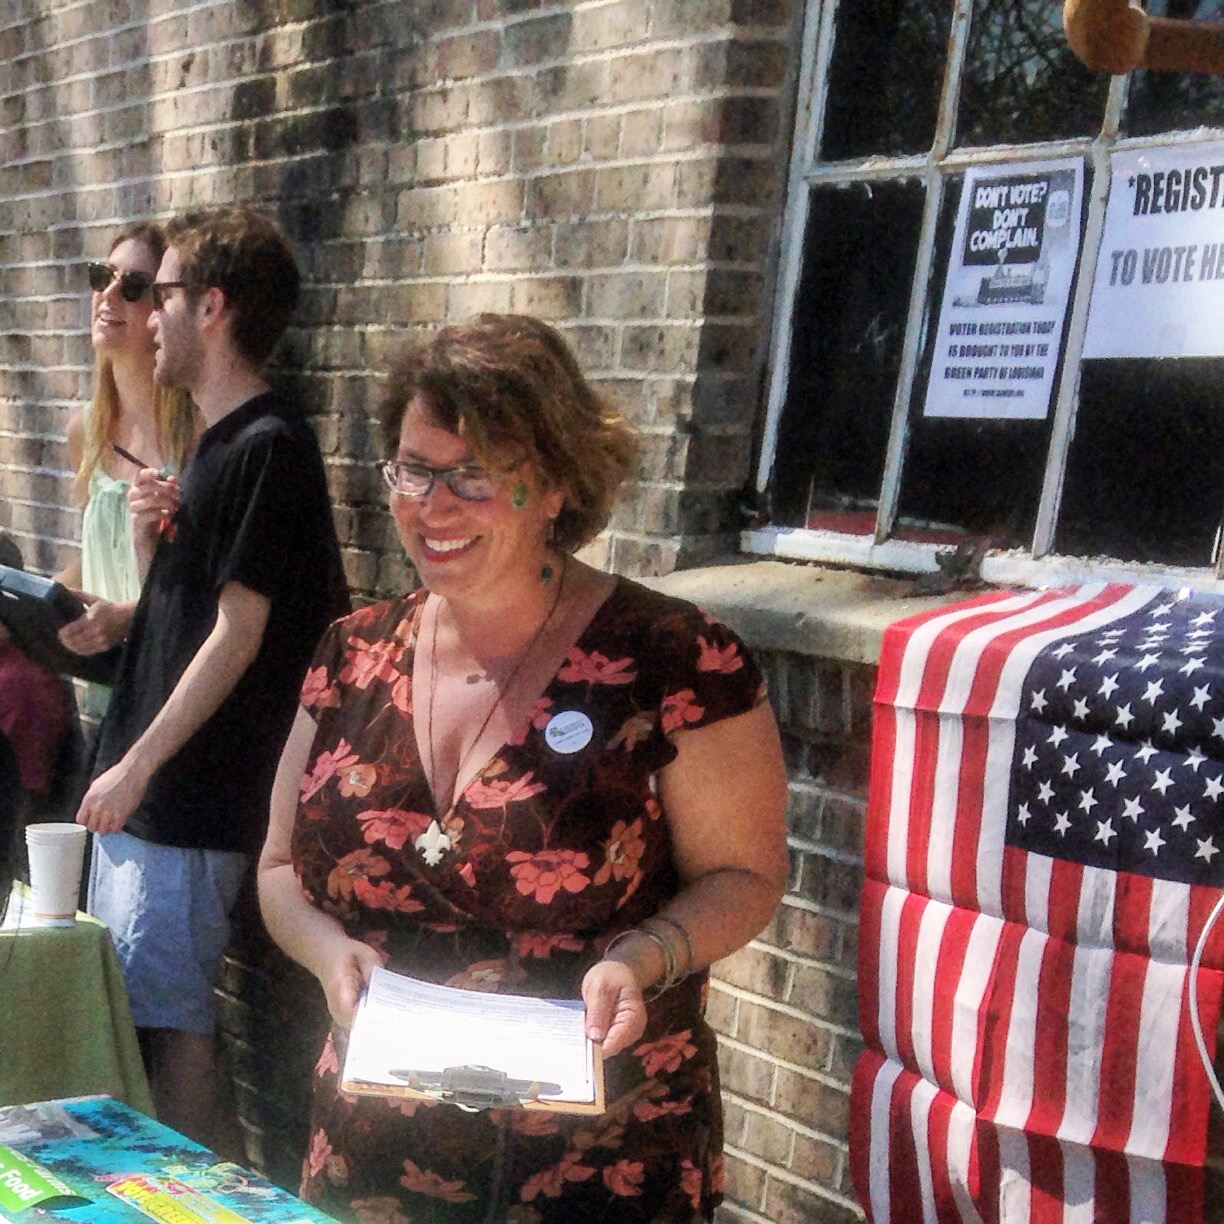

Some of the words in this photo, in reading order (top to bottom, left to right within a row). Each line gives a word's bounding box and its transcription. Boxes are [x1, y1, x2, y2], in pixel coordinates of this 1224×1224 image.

[975, 186, 1009, 209] DON'T
[1010, 181, 1048, 205] VOTE?
[1128, 165, 1224, 216] REGIST
[993, 207, 1029, 231] DON'T
[1109, 248, 1138, 287] TO
[1141, 244, 1198, 285] VOTE
